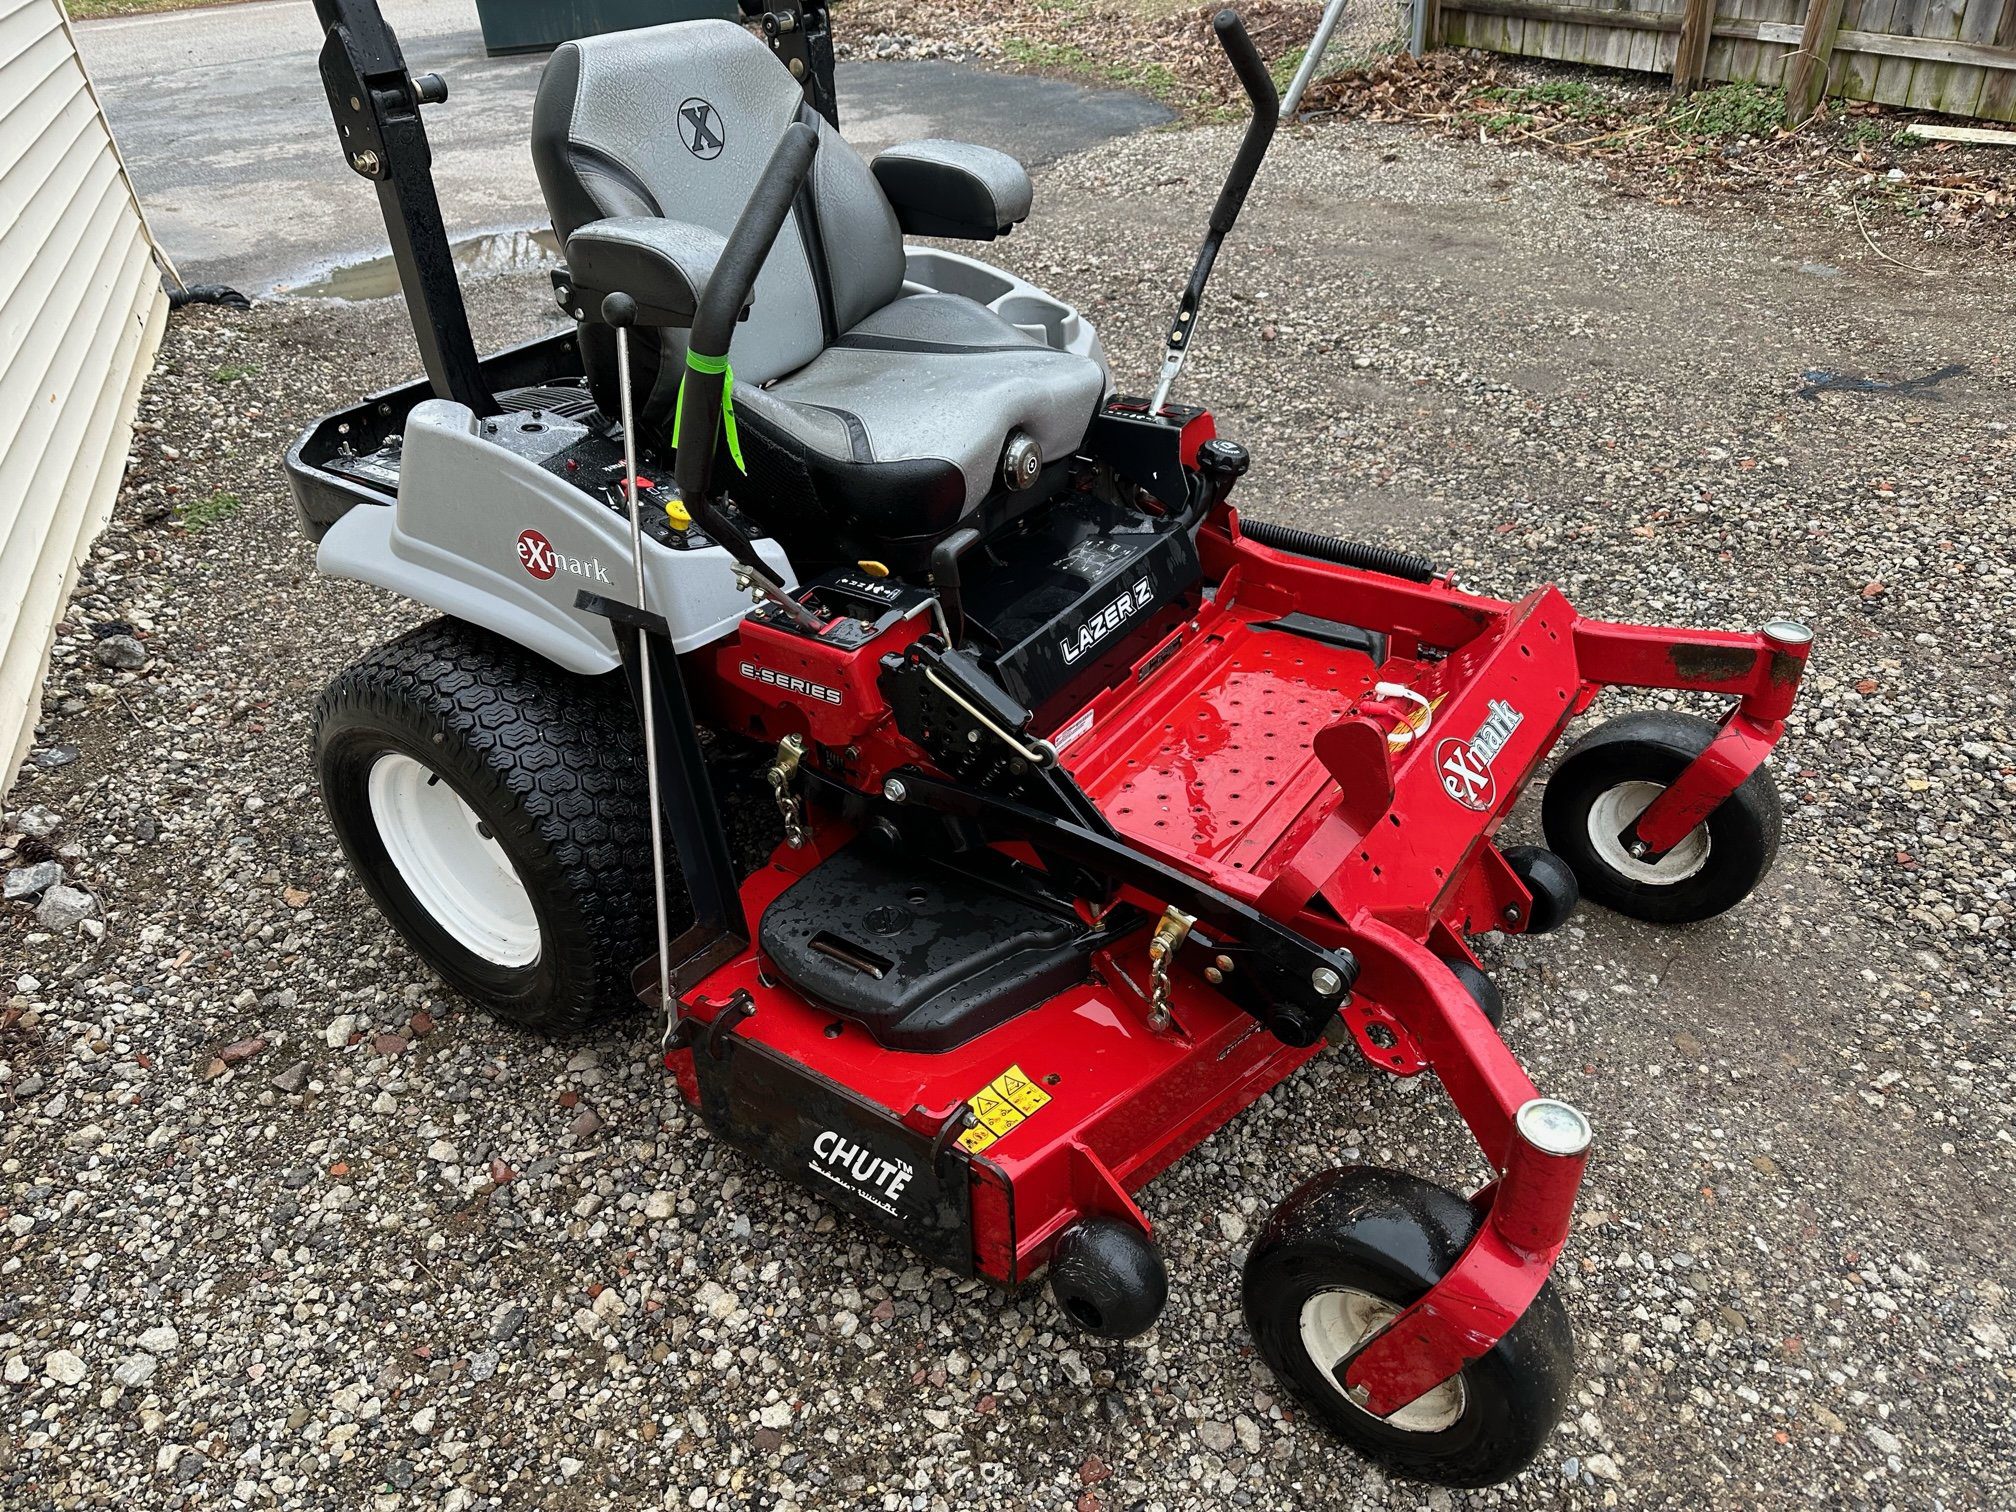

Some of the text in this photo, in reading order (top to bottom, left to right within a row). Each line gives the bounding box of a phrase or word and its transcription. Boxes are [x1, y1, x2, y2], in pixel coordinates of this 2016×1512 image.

[680, 105, 723, 152] X
[516, 536, 611, 584] eXmark
[1061, 591, 1137, 664] LAZER
[1133, 576, 1154, 610] Z
[740, 661, 842, 705] E-SERIES
[1442, 699, 1523, 804] eXmark
[813, 1130, 914, 1201] CHUTE
[895, 1157, 914, 1175] TM
